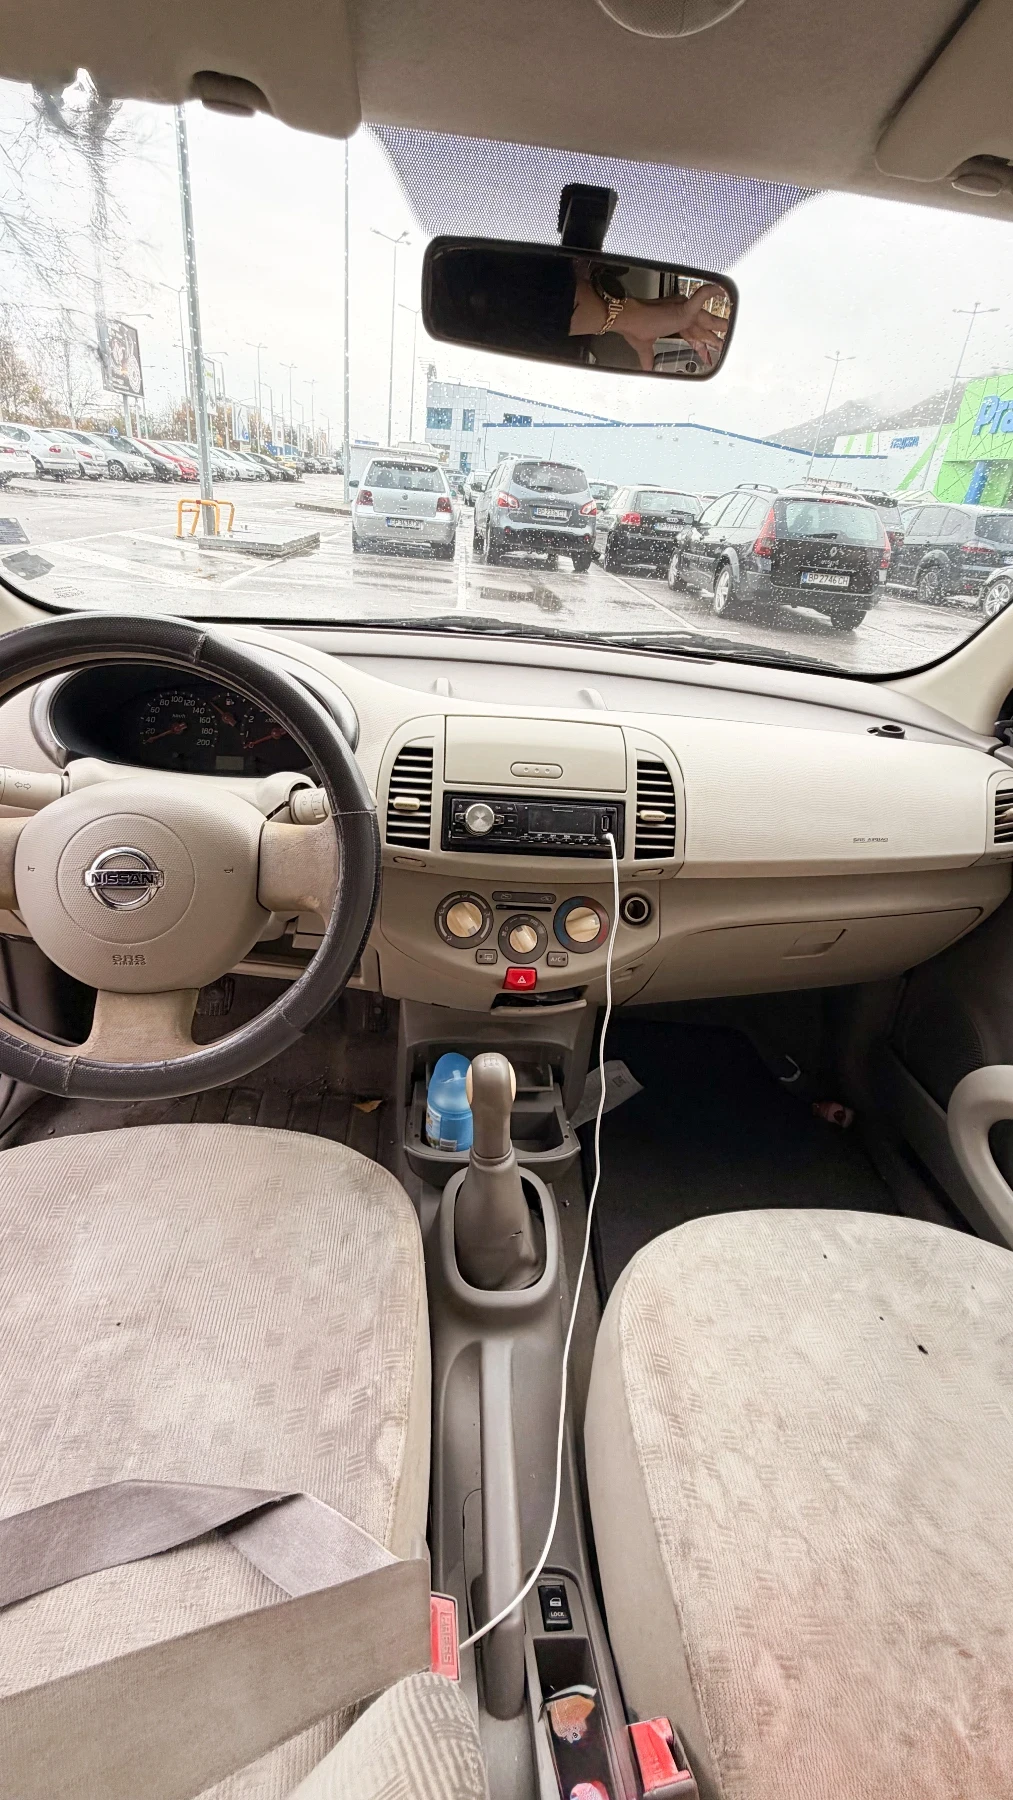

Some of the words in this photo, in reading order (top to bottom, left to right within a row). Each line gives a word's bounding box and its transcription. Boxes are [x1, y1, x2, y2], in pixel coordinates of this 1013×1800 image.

[808, 573, 819, 582] BP
[819, 574, 837, 584] 2746
[91, 872, 155, 885] NISSAN
[441, 1615, 452, 1664] PRESS
